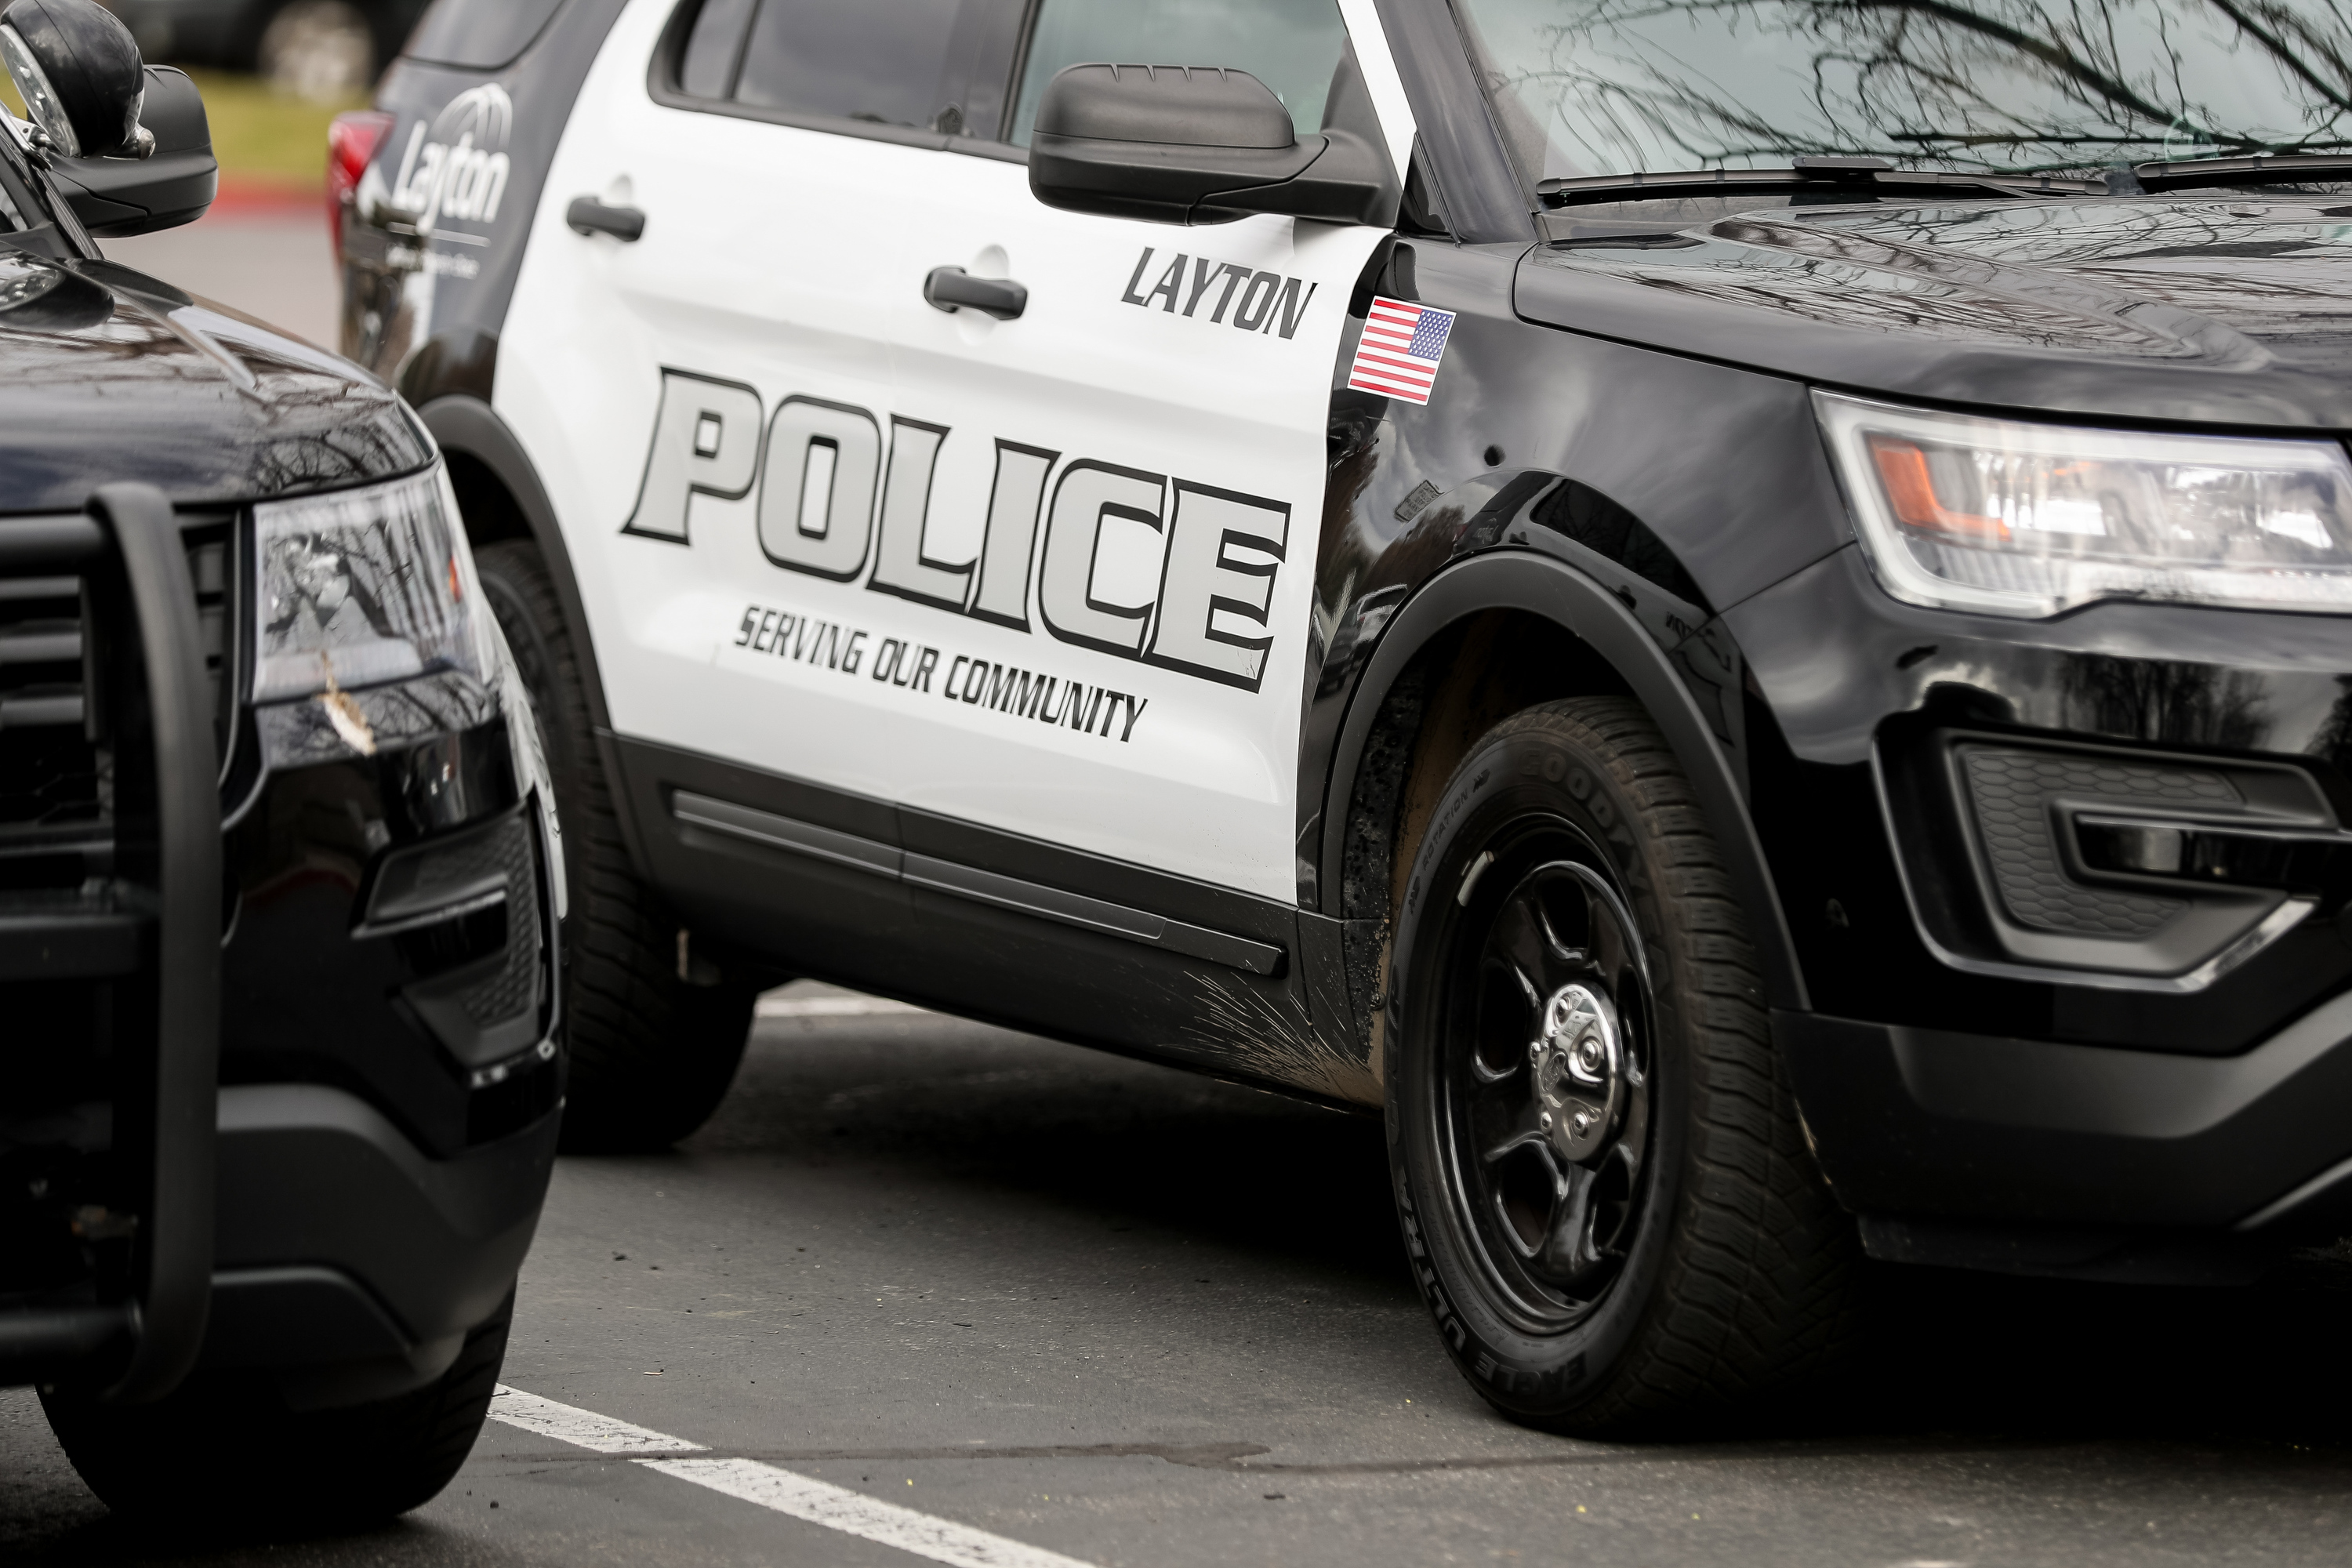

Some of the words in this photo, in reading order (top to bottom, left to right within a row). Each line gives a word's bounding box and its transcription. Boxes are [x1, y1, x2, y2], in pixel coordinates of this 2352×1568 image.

[392, 119, 510, 235] Layton
[1121, 246, 1319, 339] LAYTON
[618, 364, 1293, 694] POLICE
[733, 604, 869, 676] SERVING
[872, 638, 942, 694] OUR
[944, 654, 1149, 744] COMMUNITY
[1422, 788, 1468, 872] ROTATION
[1396, 1165, 1466, 1353] ULTRA
[1473, 1349, 1587, 1395] EAGLE
